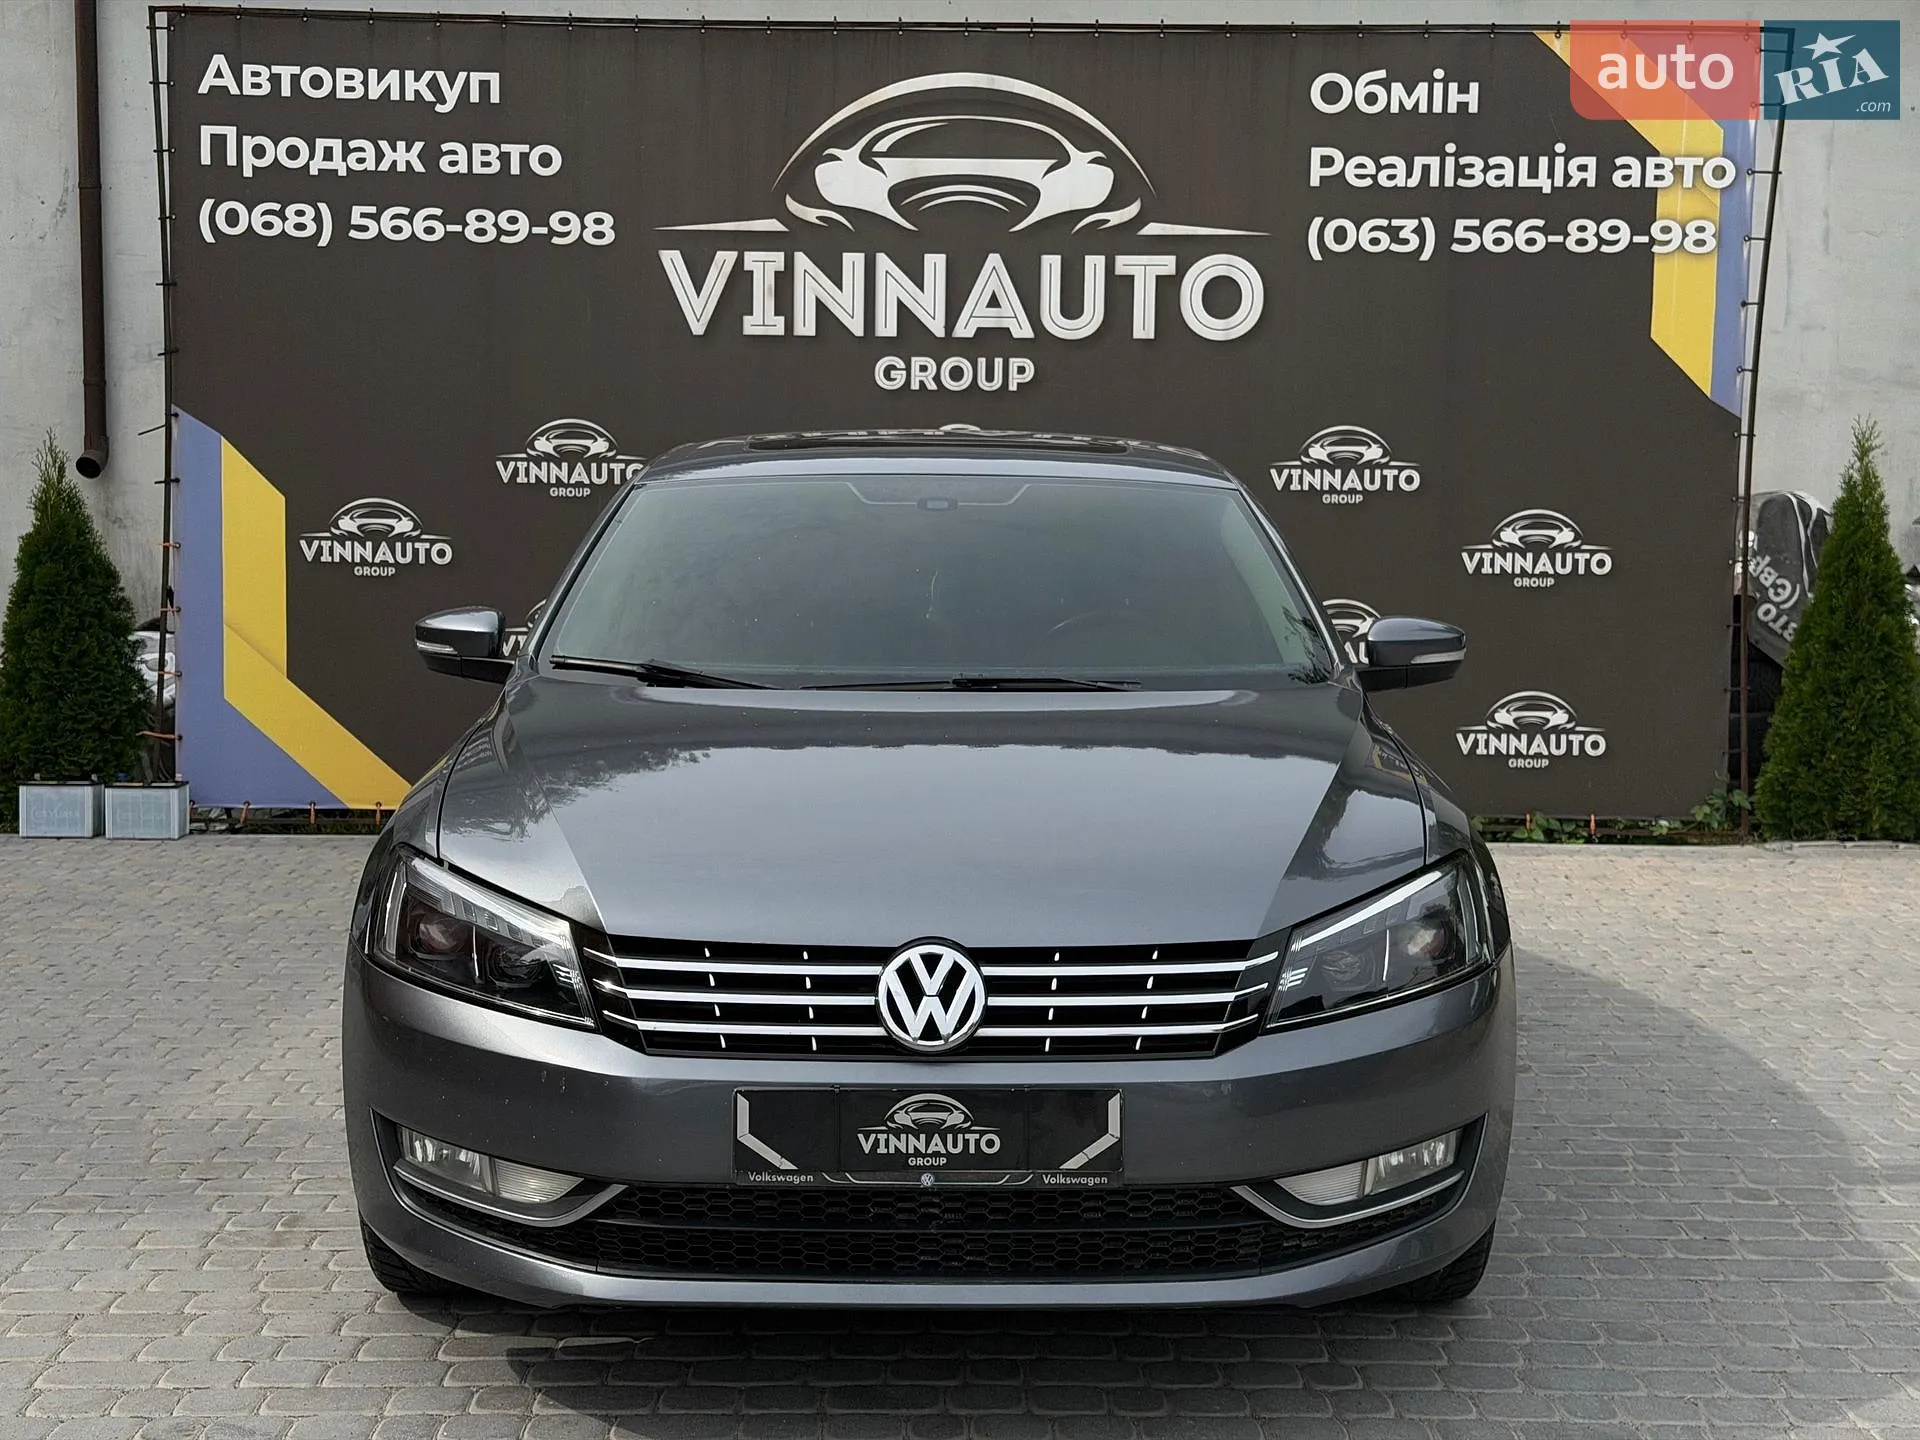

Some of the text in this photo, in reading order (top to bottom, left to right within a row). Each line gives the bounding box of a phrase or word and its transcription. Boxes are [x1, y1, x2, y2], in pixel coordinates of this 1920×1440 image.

[198, 54, 499, 113] Автовикуп
[1311, 69, 1479, 113] Обмін
[201, 125, 562, 177] Продаж авто
[1310, 143, 1736, 193] Реалізація авто
[200, 199, 615, 246] (068) 566-89-98
[1308, 217, 1716, 261] (063) 566-89-98
[659, 250, 1263, 340] VINNAUTO
[875, 356, 1034, 391] GROUP
[1270, 469, 1420, 491] VINNAUTO
[549, 487, 591, 498] GROUP
[1322, 493, 1364, 504] GROUP
[300, 541, 452, 564] VINNAUTO
[1462, 552, 1611, 575] VINNAUTO
[354, 566, 396, 577] GROUP
[1513, 577, 1555, 588] GROUP
[1456, 733, 1605, 756] VINNAUTO
[1508, 758, 1549, 769] GROUP
[858, 1134, 1000, 1153] VINNAUTO
[908, 1157, 947, 1166] GROUP
[748, 1172, 814, 1185] Volkswagen
[1043, 1174, 1108, 1186] Volkswagen
